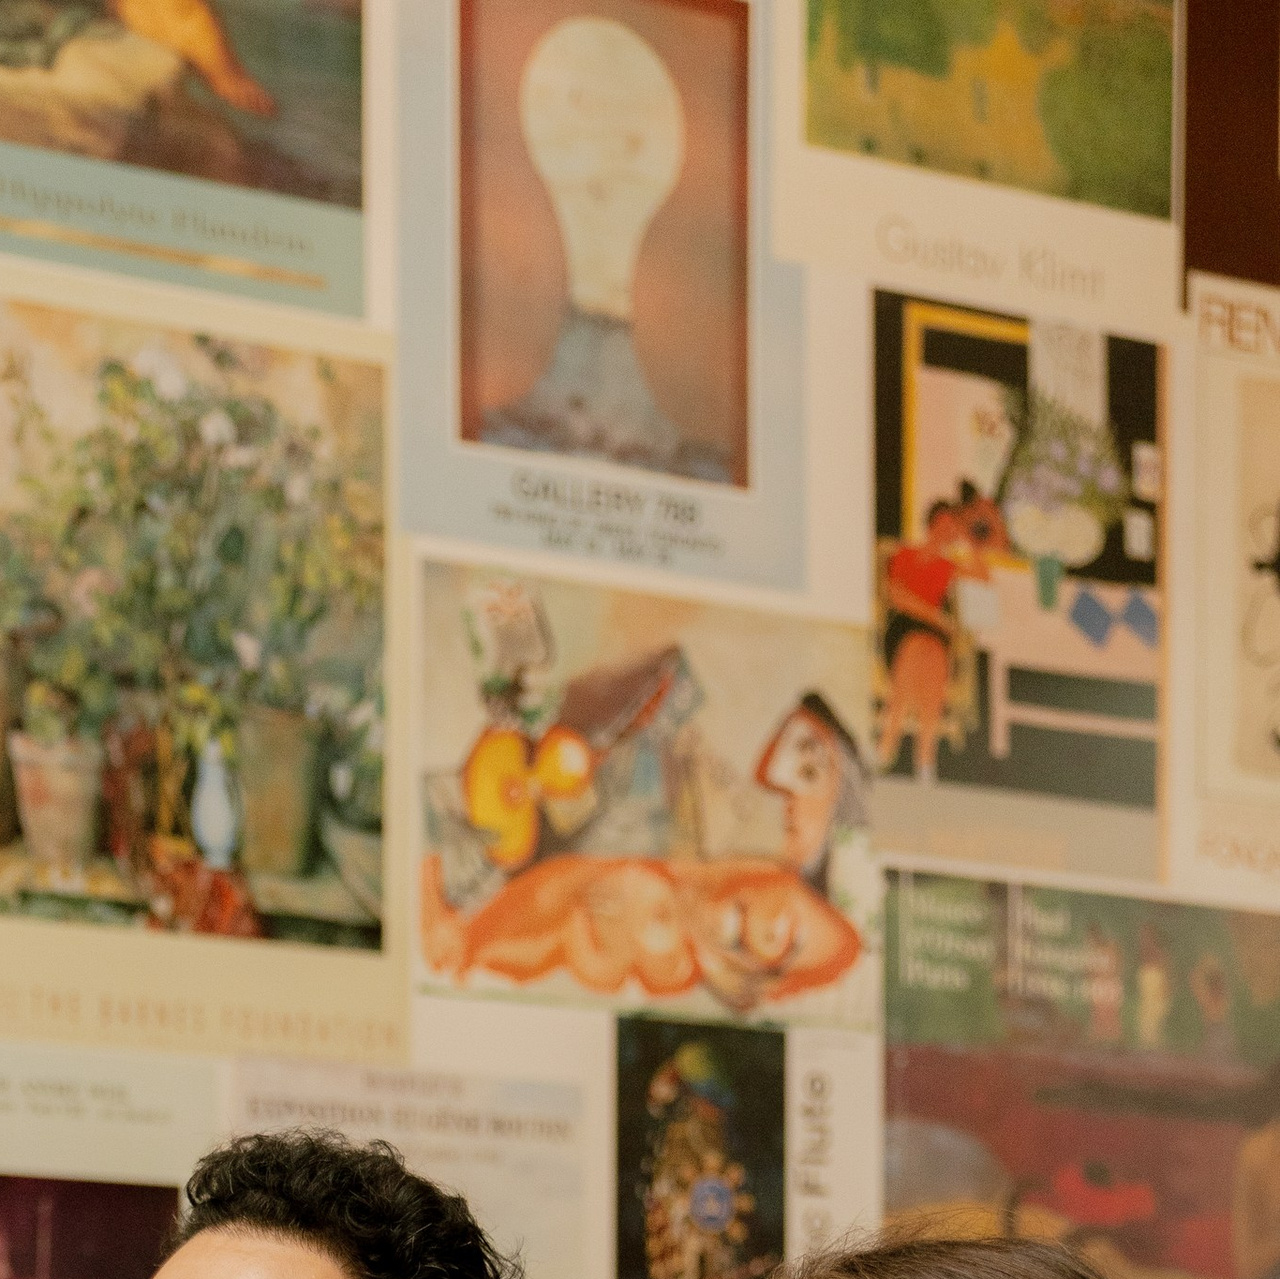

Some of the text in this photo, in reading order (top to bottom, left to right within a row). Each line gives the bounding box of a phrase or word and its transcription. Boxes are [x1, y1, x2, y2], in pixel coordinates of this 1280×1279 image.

[874, 212, 1104, 296] Gustav Klimt
[510, 468, 647, 513] GALLERY
